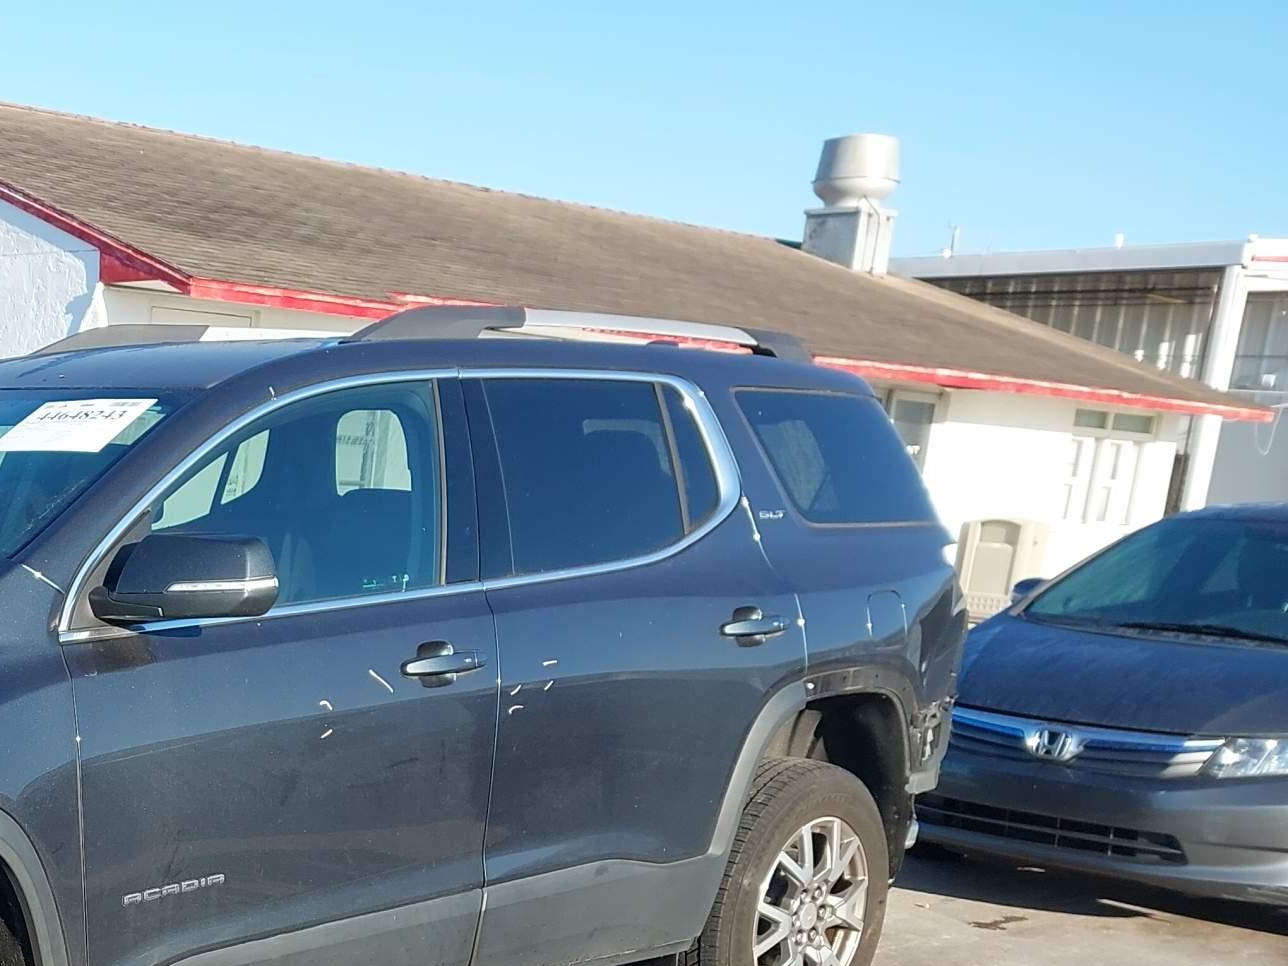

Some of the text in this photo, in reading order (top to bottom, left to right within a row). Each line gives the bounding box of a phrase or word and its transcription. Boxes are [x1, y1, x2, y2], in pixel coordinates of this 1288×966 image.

[38, 410, 128, 421] 44648243
[759, 510, 785, 520] SLT
[122, 874, 225, 905] ACADIA
